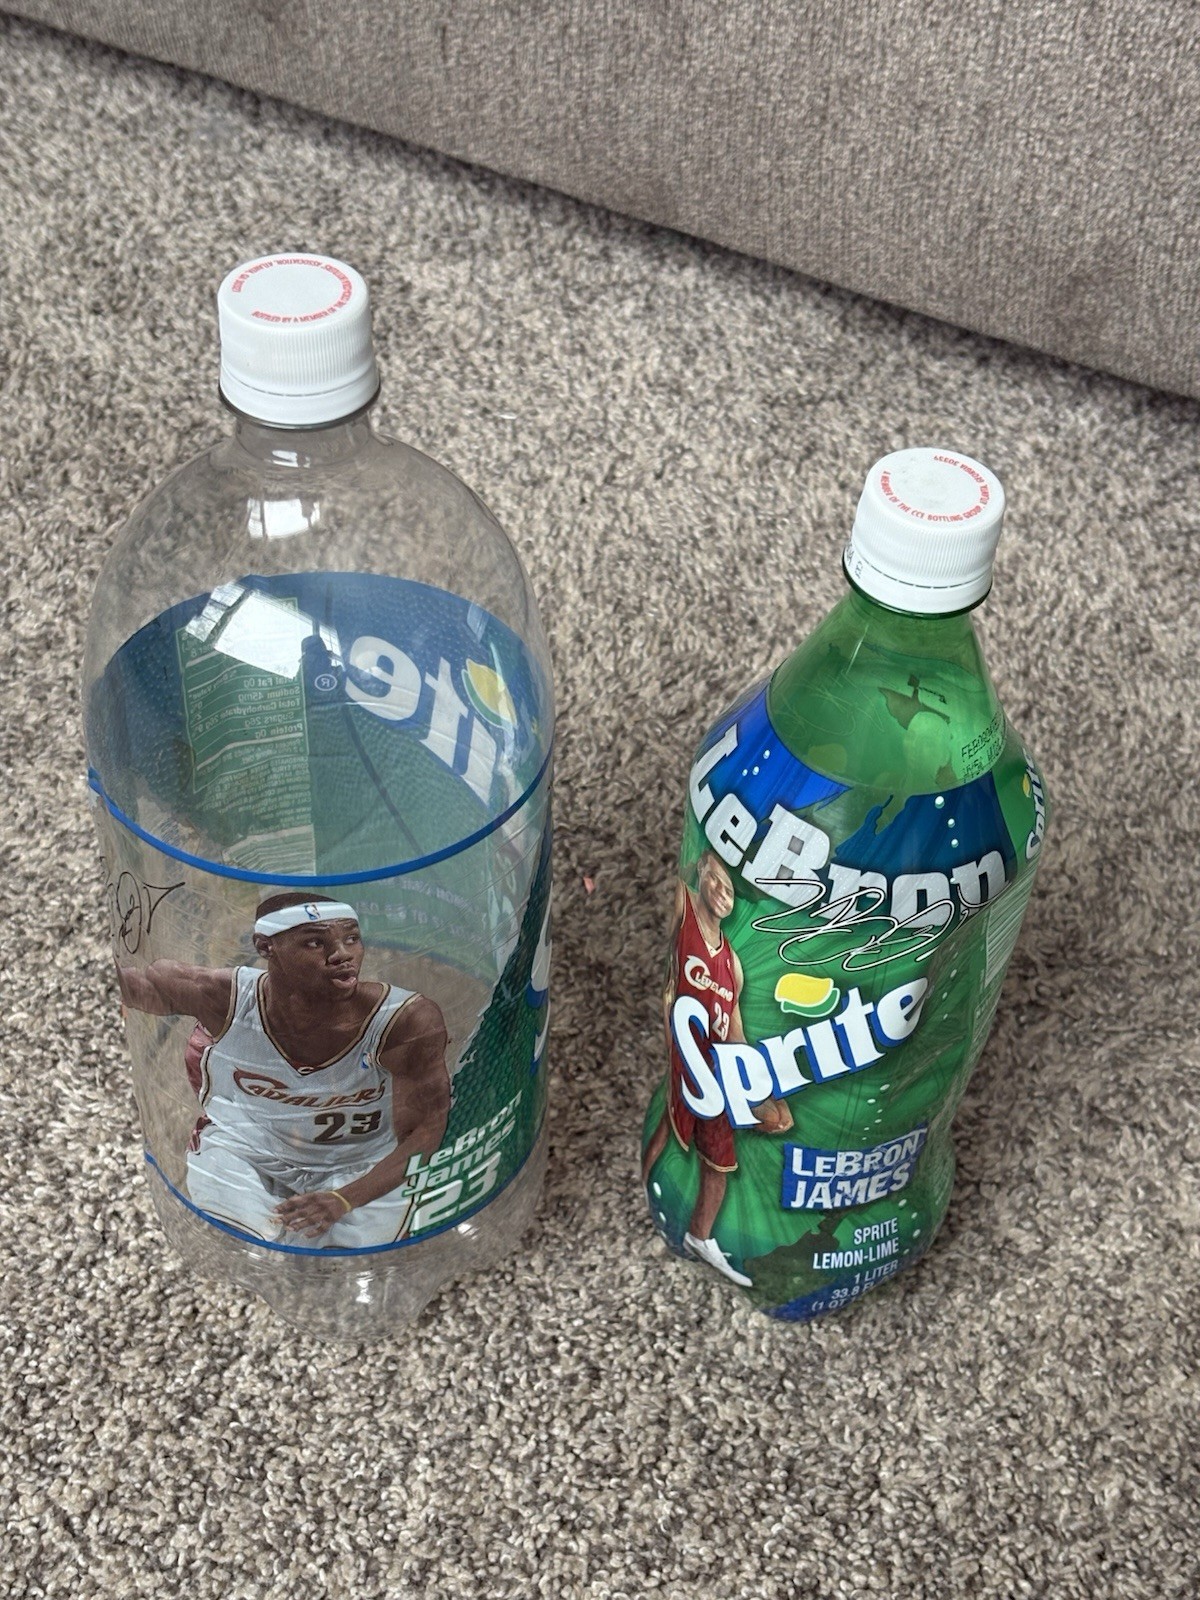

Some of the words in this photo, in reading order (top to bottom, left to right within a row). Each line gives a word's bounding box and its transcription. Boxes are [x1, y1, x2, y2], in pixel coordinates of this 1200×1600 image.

[898, 503, 911, 512] THE
[928, 514, 964, 522] BOTTLING
[689, 723, 1009, 929] LeBron
[712, 1002, 730, 1042] 23
[673, 978, 928, 1126] Sprite
[313, 1110, 382, 1144] 23
[404, 1089, 522, 1178] LeBron
[402, 1118, 516, 1197] James
[413, 1151, 502, 1231] 23
[790, 1162, 911, 1210] JAMES
[853, 1217, 898, 1245] SPRITE
[812, 1237, 899, 1270] LEMON-LIME
[854, 1272, 861, 1285] 1
[864, 1259, 899, 1281] LITER
[831, 1285, 860, 1300] 33.8
